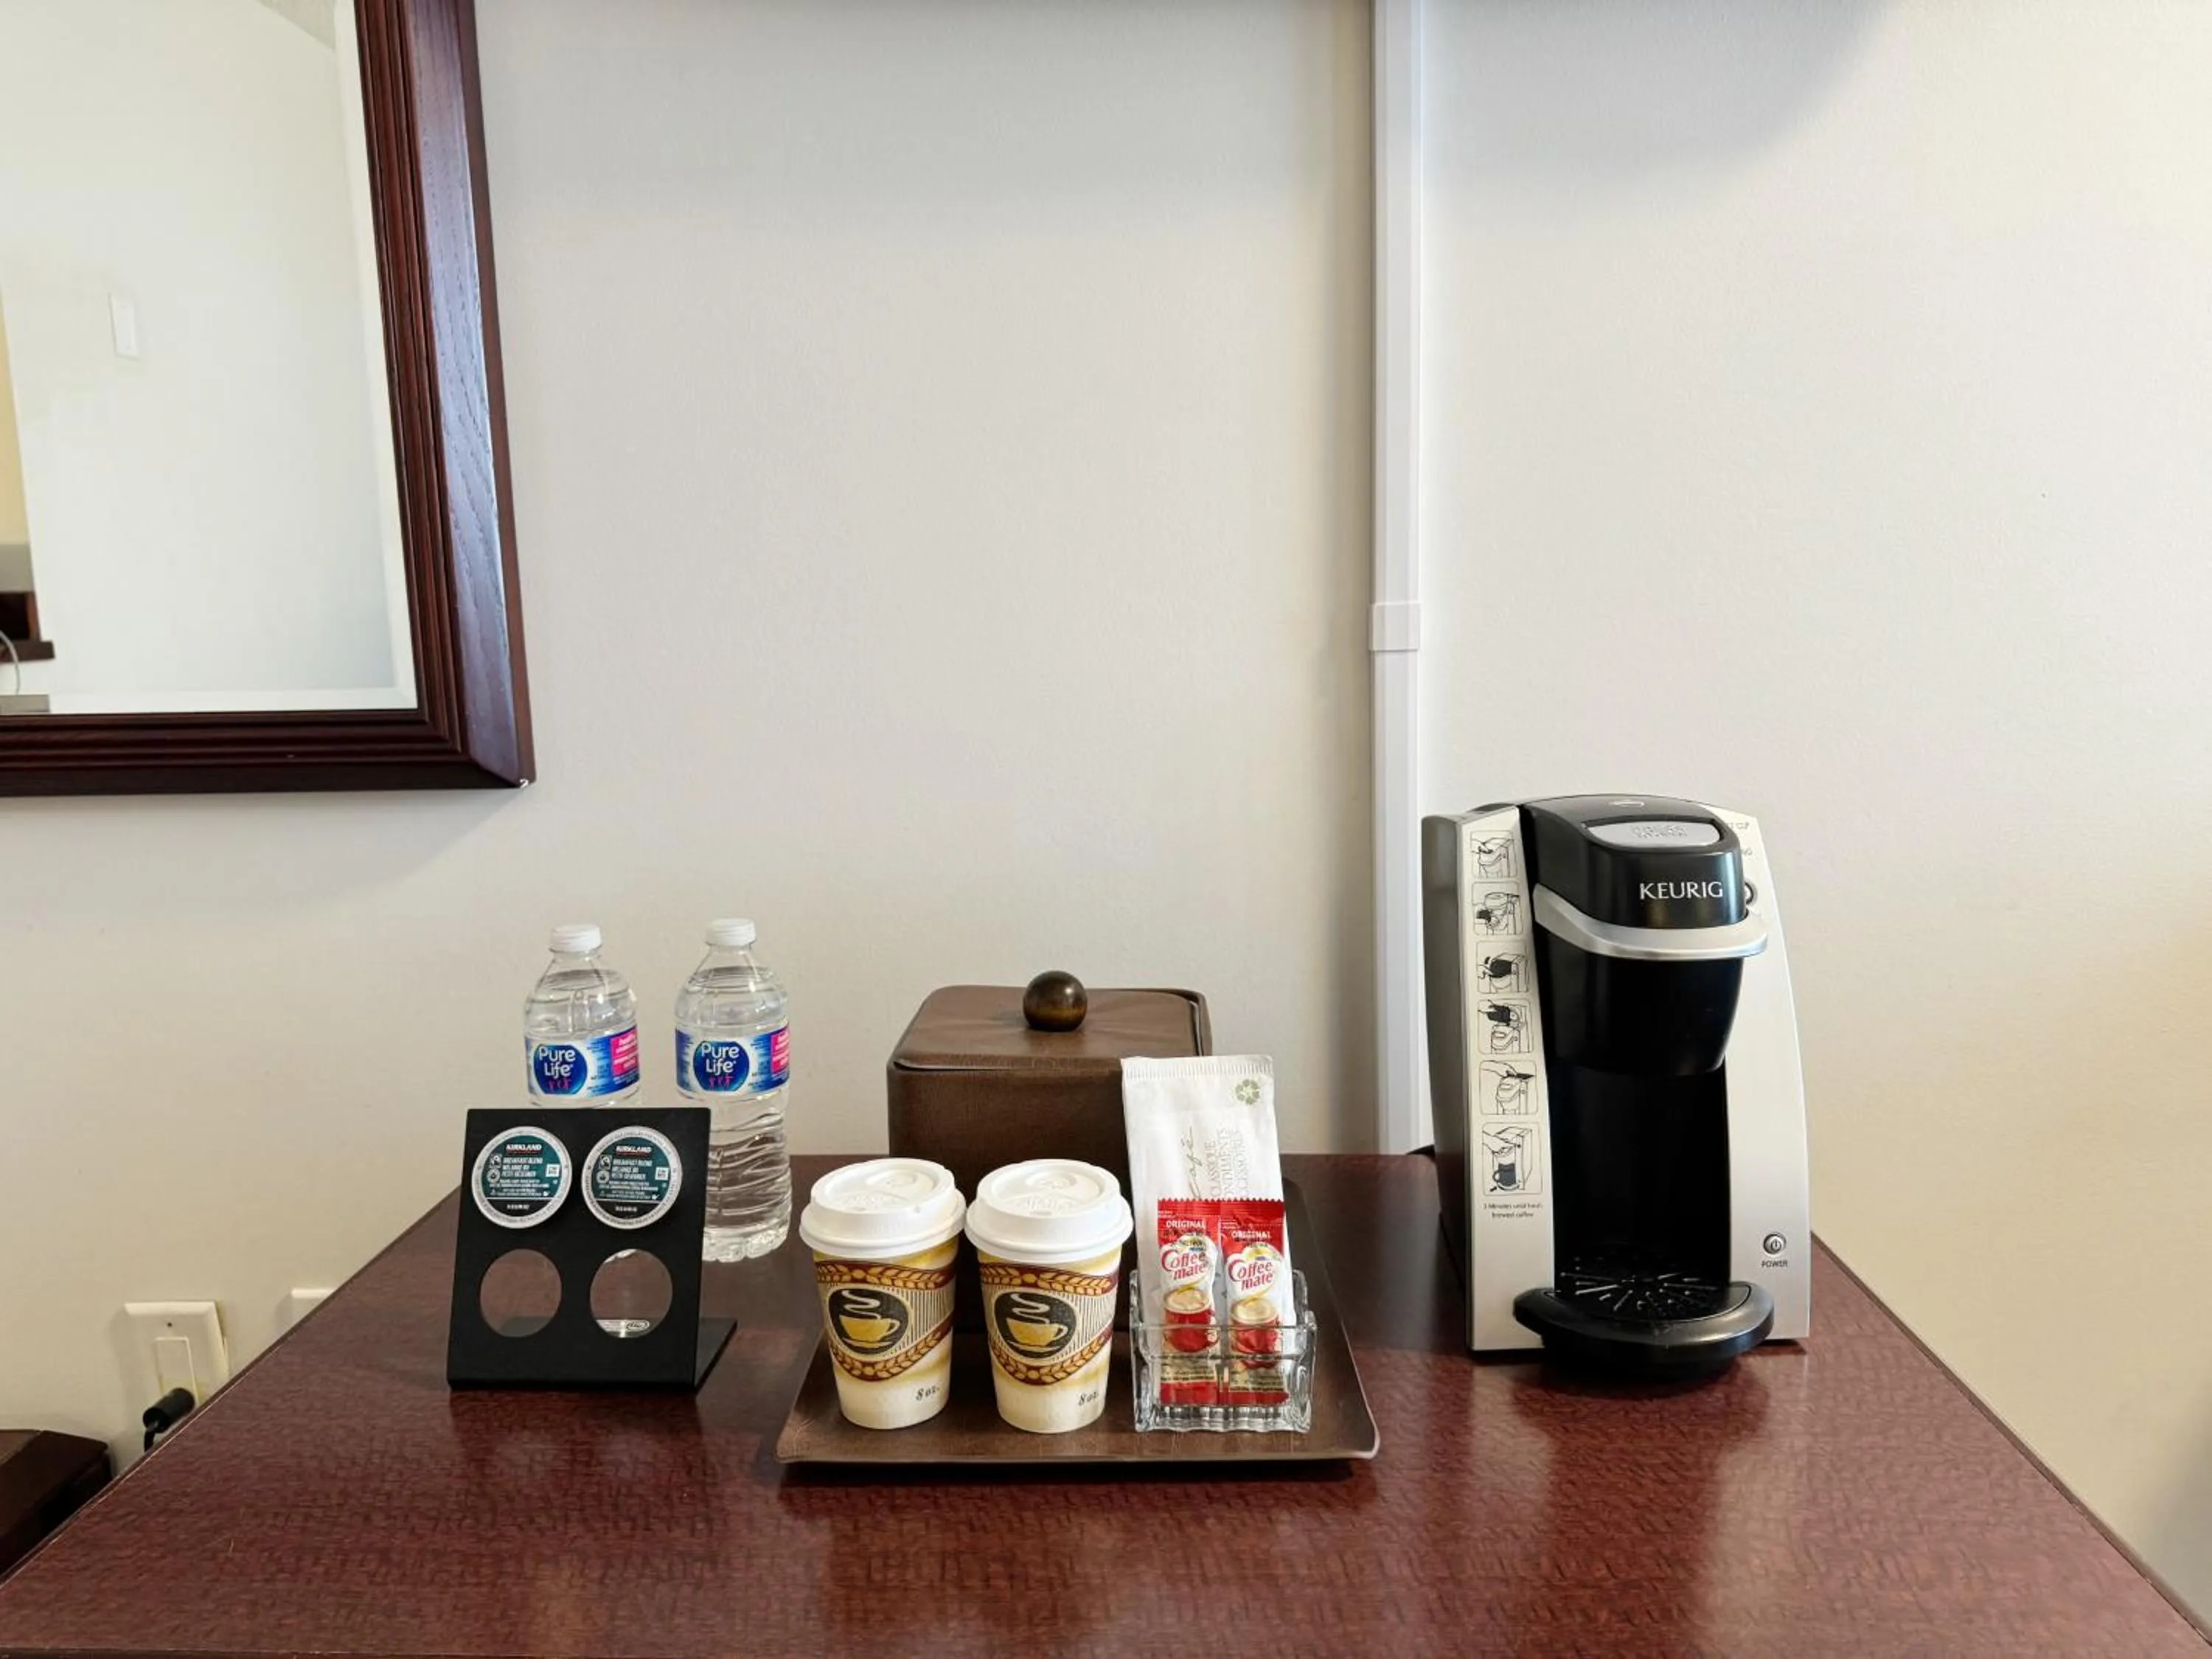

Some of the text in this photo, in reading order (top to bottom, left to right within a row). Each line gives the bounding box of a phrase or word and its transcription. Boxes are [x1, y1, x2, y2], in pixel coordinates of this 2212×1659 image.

[1639, 880, 1723, 900] KEURIG
[538, 1046, 576, 1062] Pure
[701, 1042, 740, 1059] Pure
[543, 1062, 571, 1079] Life
[705, 1058, 734, 1076] Life
[1166, 1220, 1206, 1228] ORIGINAL
[1231, 1230, 1271, 1239] ORIGINAL
[1161, 1250, 1206, 1272] Coffee
[1761, 1259, 1788, 1268] POWER
[1172, 1263, 1206, 1281] mate
[1228, 1259, 1273, 1282] Coffee
[1241, 1273, 1273, 1291] mate
[916, 1388, 924, 1401] 8
[1078, 1393, 1086, 1406] 8
